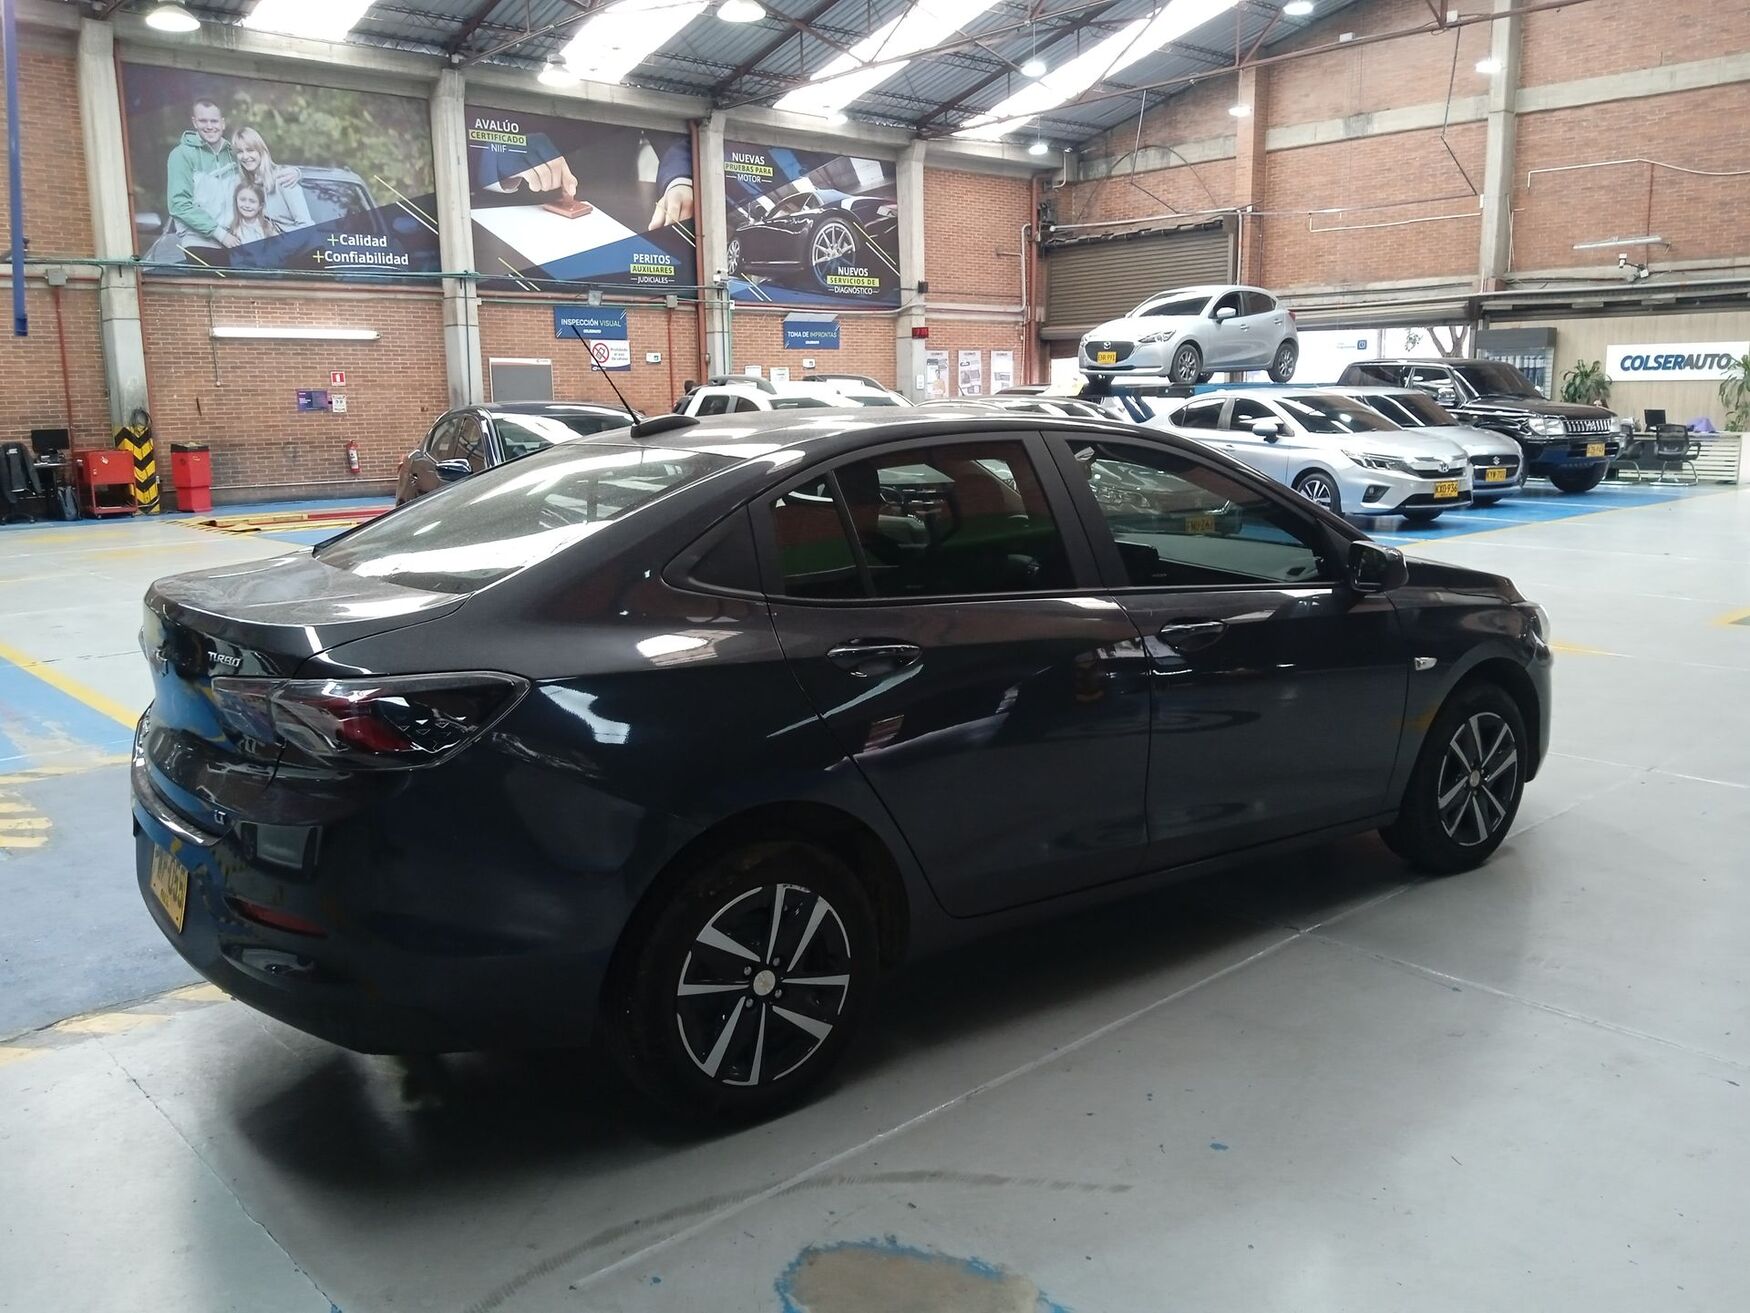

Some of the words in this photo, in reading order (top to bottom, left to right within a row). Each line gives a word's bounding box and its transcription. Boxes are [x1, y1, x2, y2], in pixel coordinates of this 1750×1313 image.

[475, 118, 519, 133] AVALÚO
[470, 131, 525, 144] CERTIFICADO
[491, 143, 507, 152] NIIF
[732, 152, 765, 165] NUEVAS
[725, 162, 754, 173] PRUEBAS
[755, 167, 772, 175] PARA
[737, 174, 761, 183] MOTOR
[633, 253, 671, 264] PERITOS
[632, 265, 673, 274] AUXILIARES
[837, 266, 869, 276] NUEVOS
[637, 276, 669, 284] JUDICIALES
[830, 276, 865, 285] SERVICIOS
[560, 318, 599, 327] INSPECCIÓN
[600, 320, 621, 328] VISUAL
[1620, 353, 1732, 372] COLSERAUTO
[207, 651, 241, 668] TURBO
